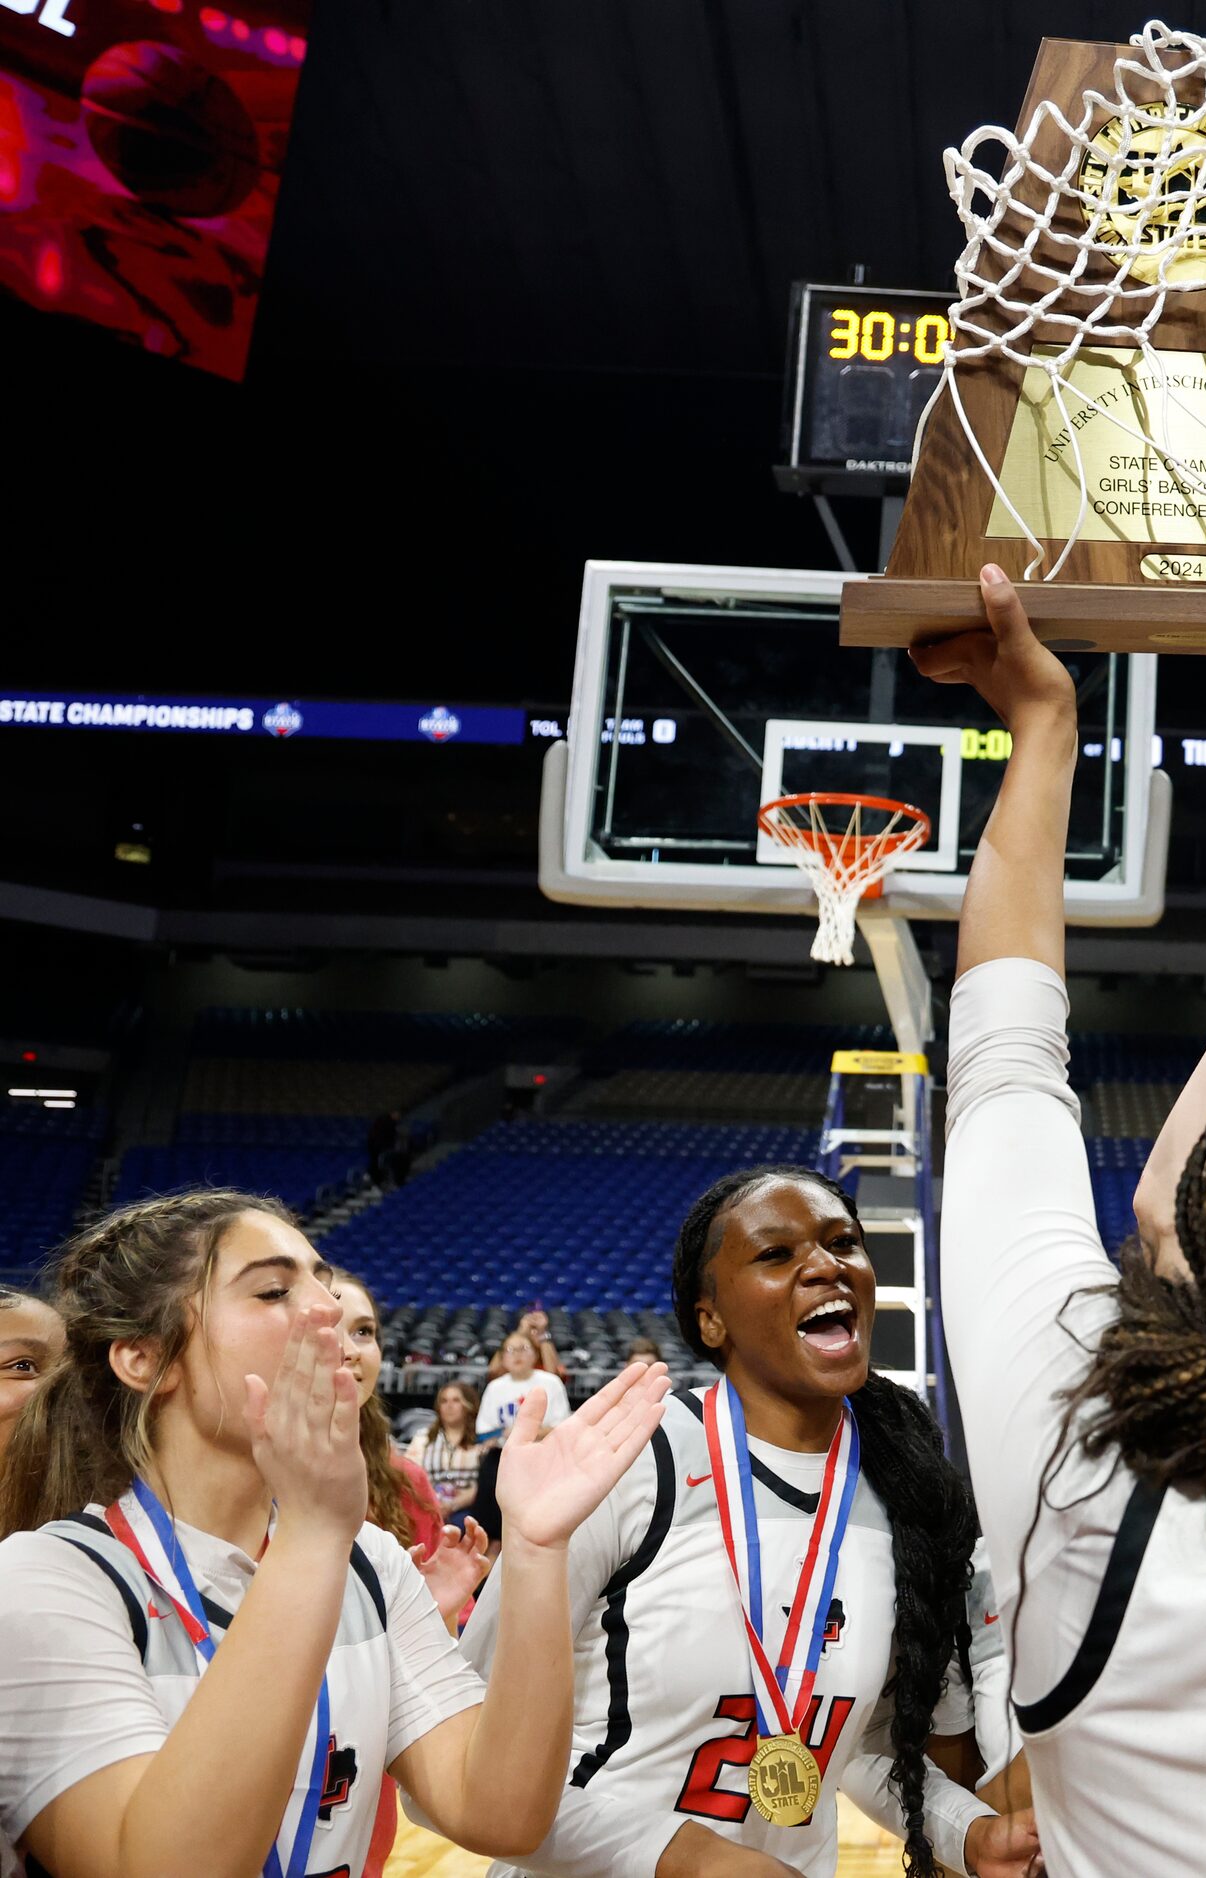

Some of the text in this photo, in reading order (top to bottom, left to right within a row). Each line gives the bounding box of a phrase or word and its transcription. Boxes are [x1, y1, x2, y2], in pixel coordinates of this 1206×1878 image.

[828, 308, 956, 365] 30:0
[1109, 455, 1159, 471] STATE
[1099, 478, 1153, 493] GIRLS'
[1159, 560, 1204, 577] 2024
[0, 699, 66, 724] STATE
[66, 702, 254, 731] CHAMPIONSHIPS
[530, 720, 563, 737] TOL
[674, 1694, 857, 1828] 24
[759, 1761, 806, 1798] UIL
[771, 1794, 800, 1809] STATE
